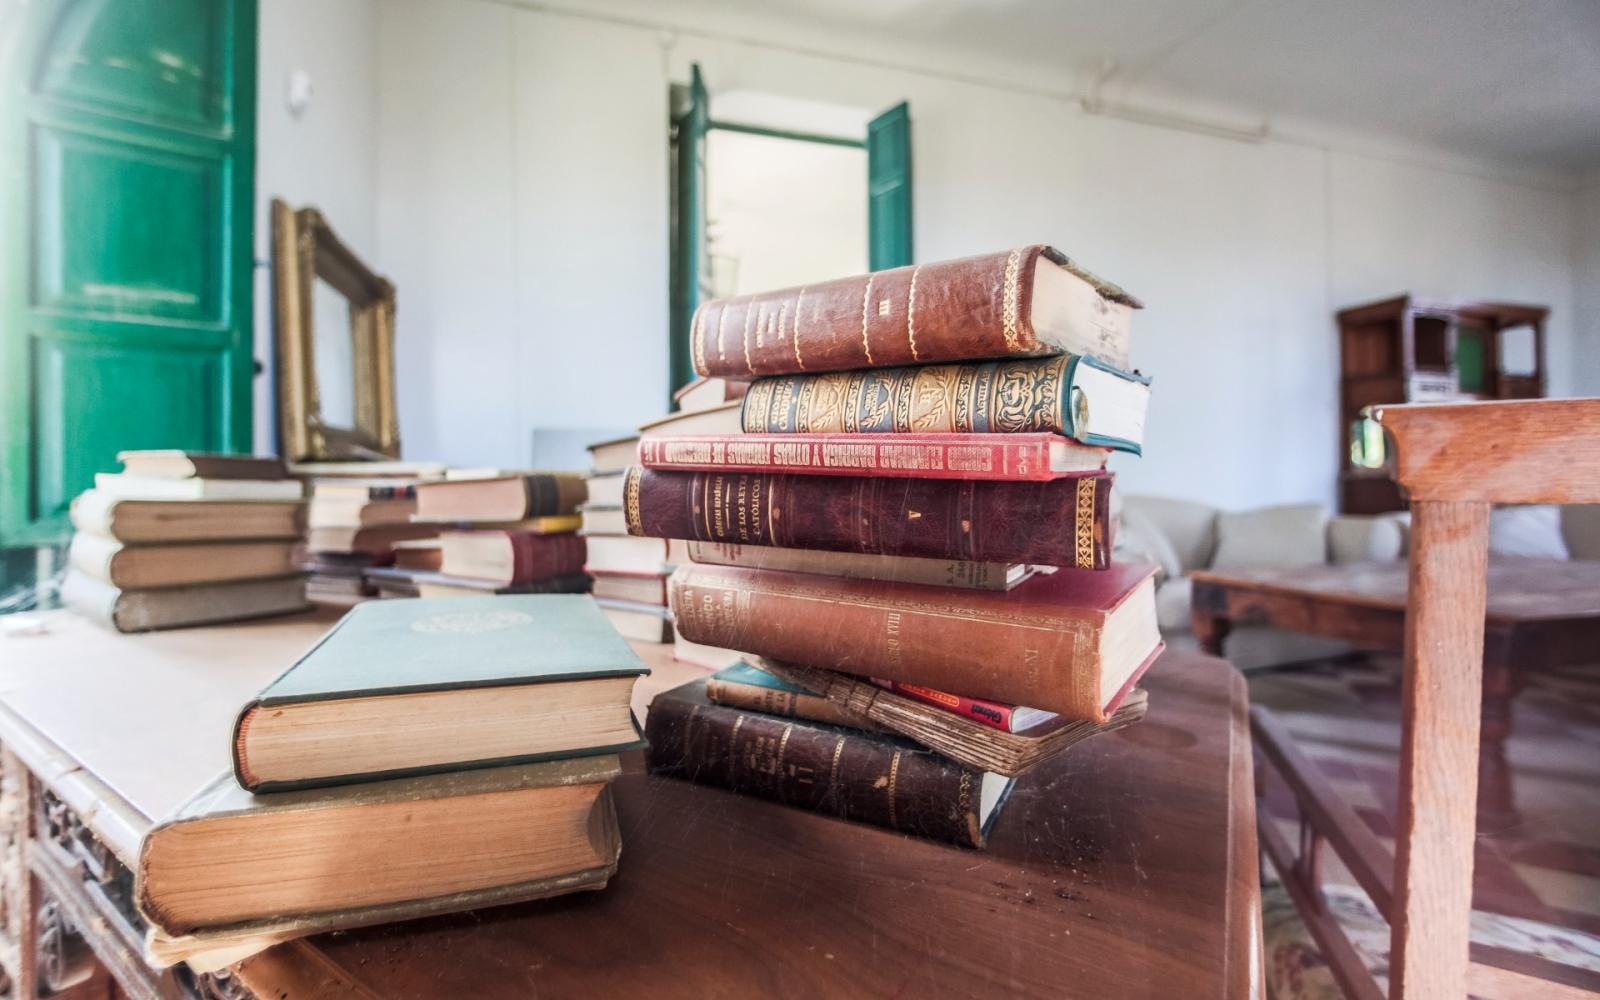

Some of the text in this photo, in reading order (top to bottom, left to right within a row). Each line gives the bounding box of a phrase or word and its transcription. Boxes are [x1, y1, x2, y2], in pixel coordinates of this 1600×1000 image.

[711, 443, 725, 464] DE
[773, 443, 810, 466] OTRAS
[811, 443, 822, 466] Y
[823, 443, 876, 468] BARRIGA
[880, 445, 943, 471] ELIMINAR
[947, 446, 992, 472] COMO
[738, 506, 746, 525] LOS
[750, 480, 761, 535] CATÓLICOS
[887, 613, 901, 636] XVIII
